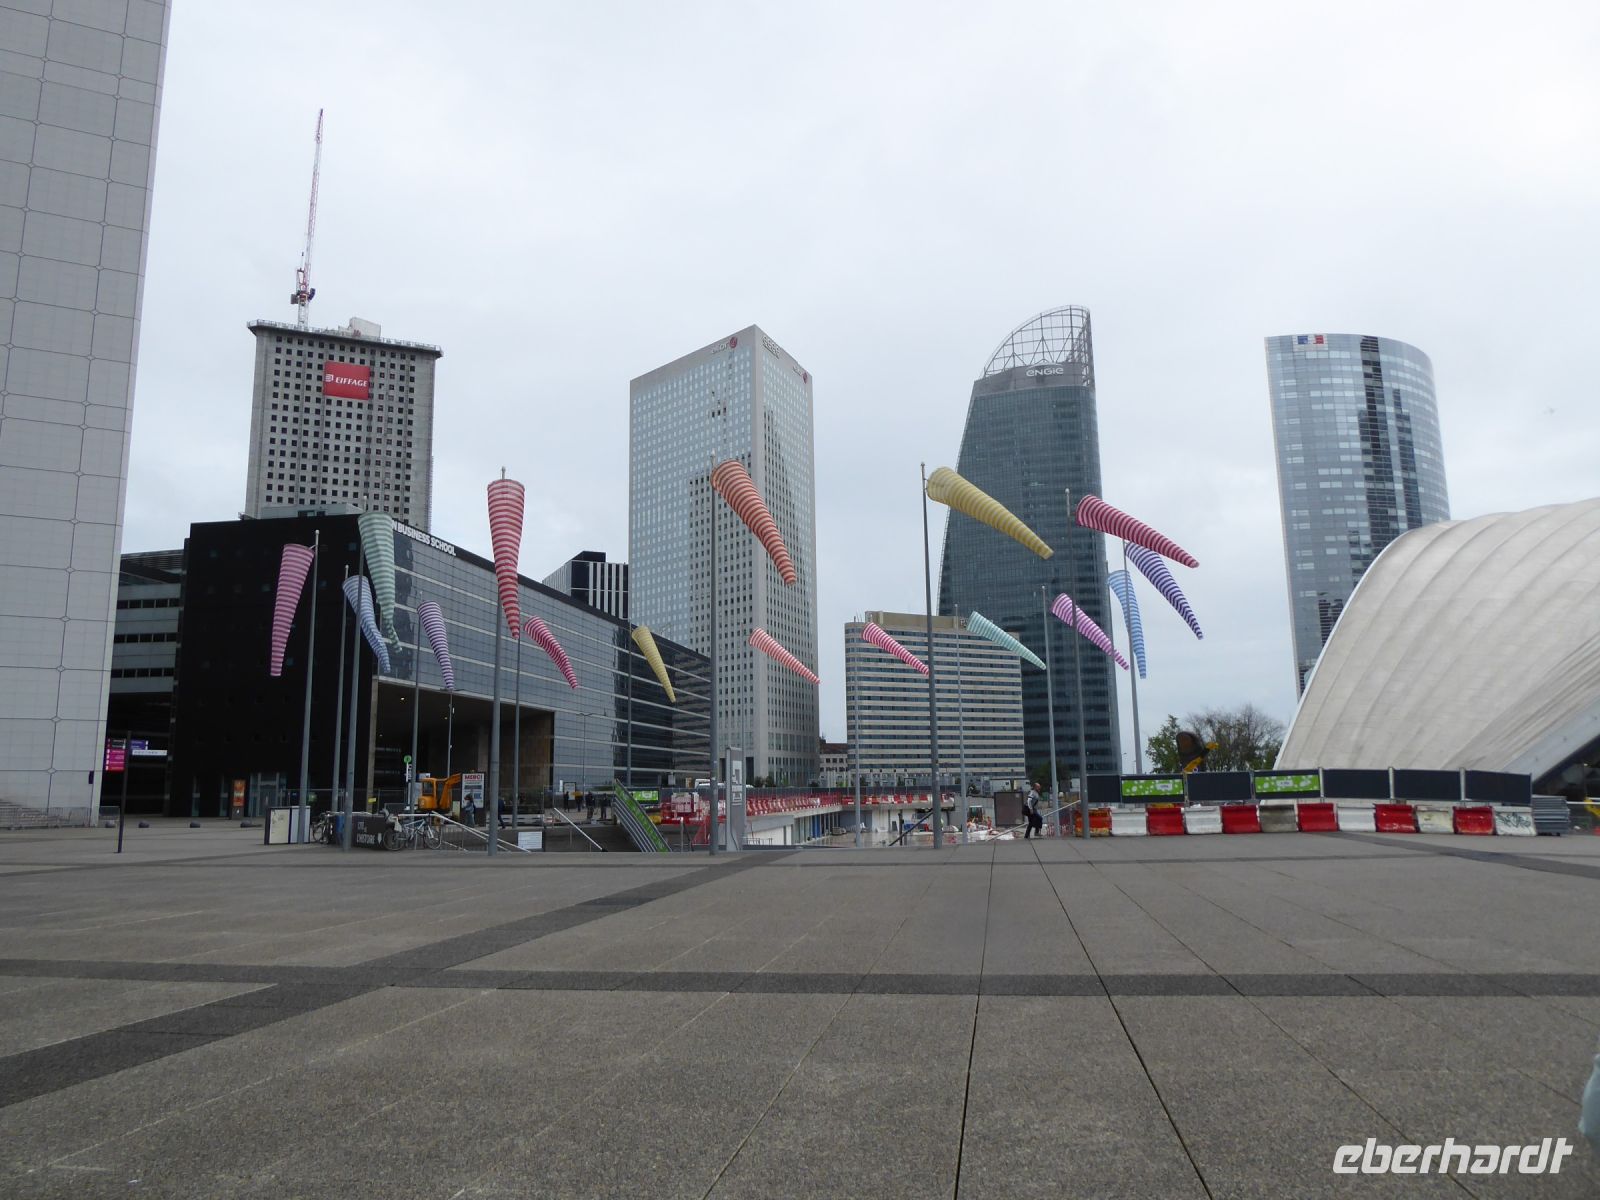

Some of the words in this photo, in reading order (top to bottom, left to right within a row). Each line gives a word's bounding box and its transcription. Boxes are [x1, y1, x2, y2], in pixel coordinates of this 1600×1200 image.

[335, 376, 368, 387] EIFFAGE
[397, 522, 430, 545] BUSINESS
[430, 537, 457, 556] SCHOOL
